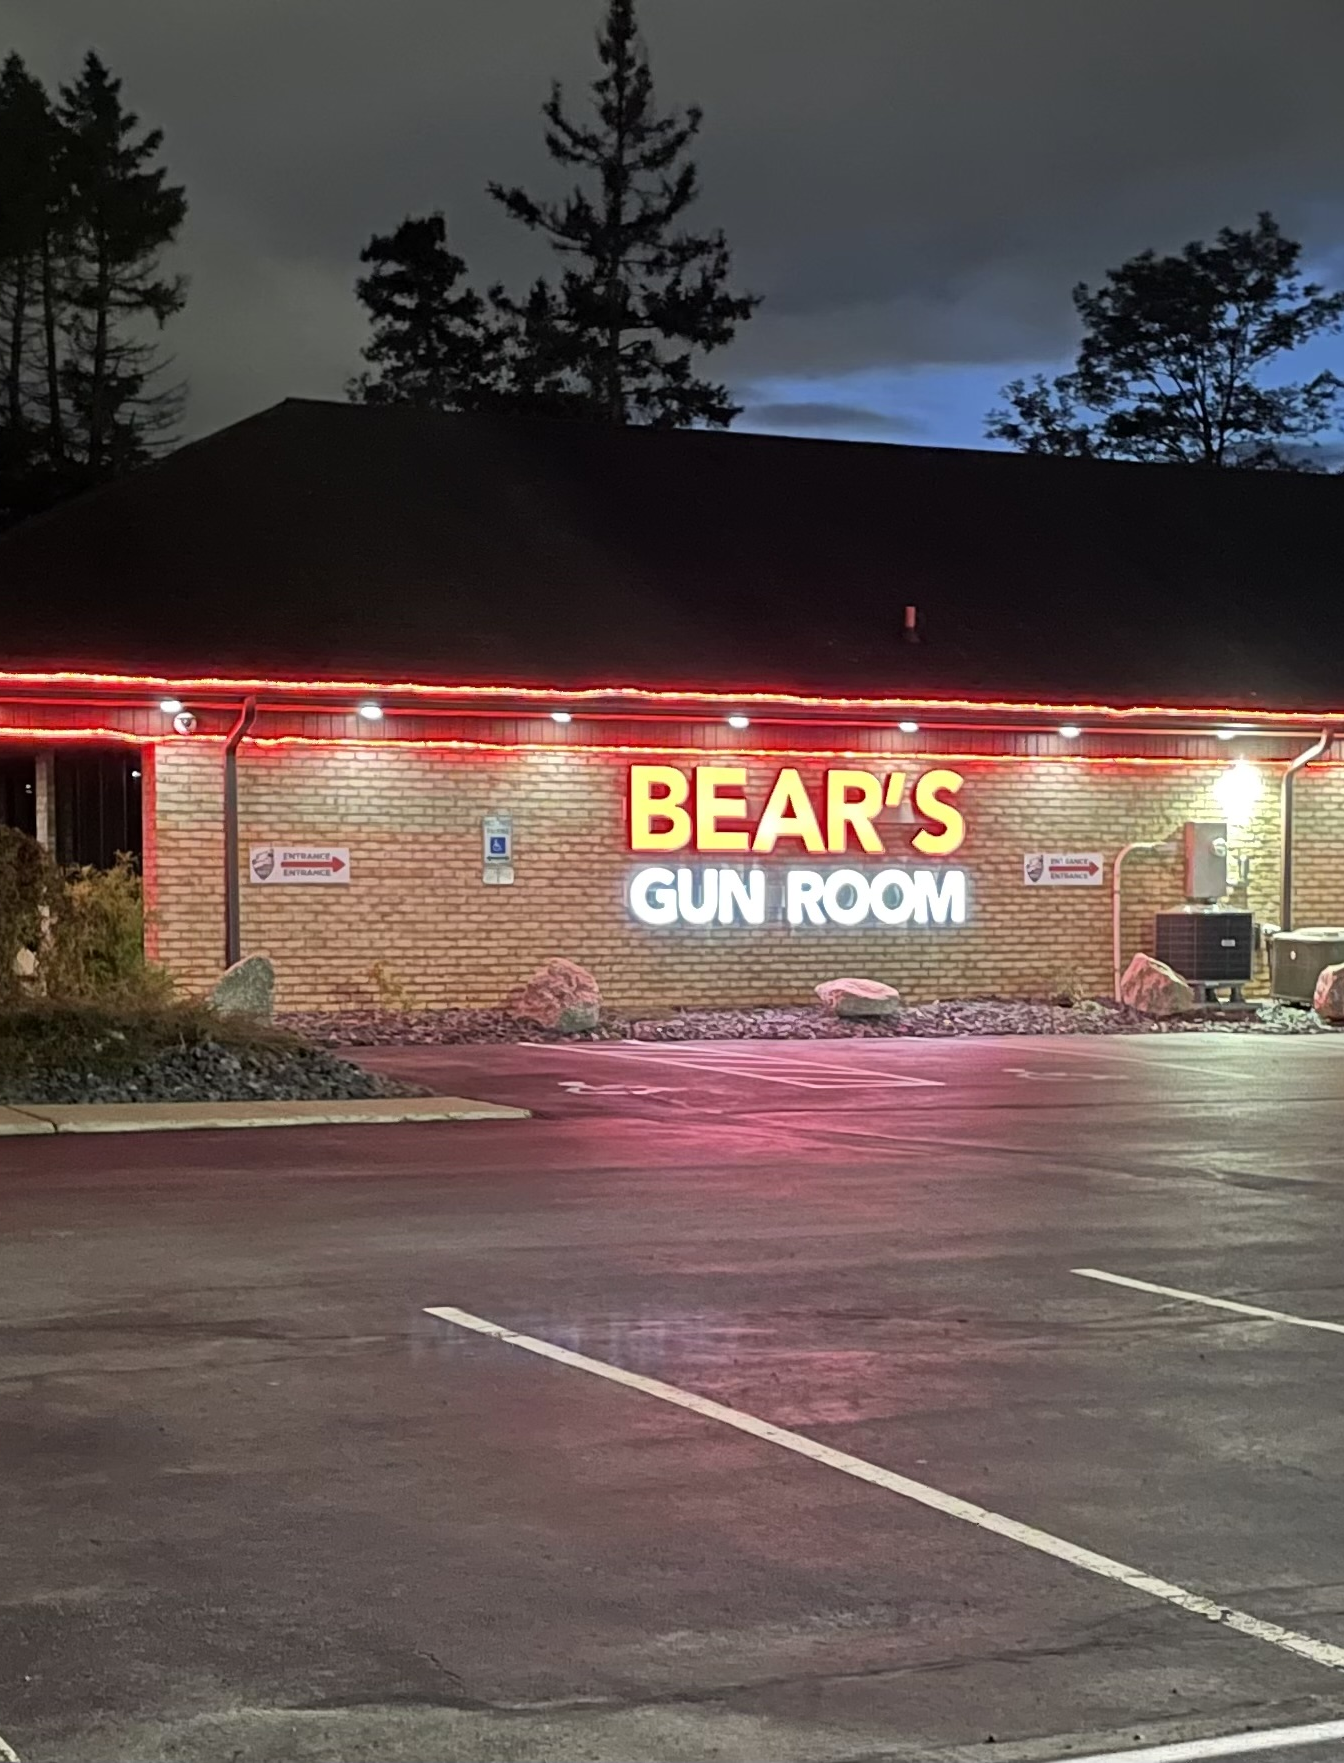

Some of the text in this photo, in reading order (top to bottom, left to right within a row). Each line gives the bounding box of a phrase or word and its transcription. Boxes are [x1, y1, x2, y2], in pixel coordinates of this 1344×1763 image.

[629, 765, 966, 855] BEAR'S
[283, 852, 330, 860] ENTRANCE
[630, 867, 966, 925] GUN ROOM
